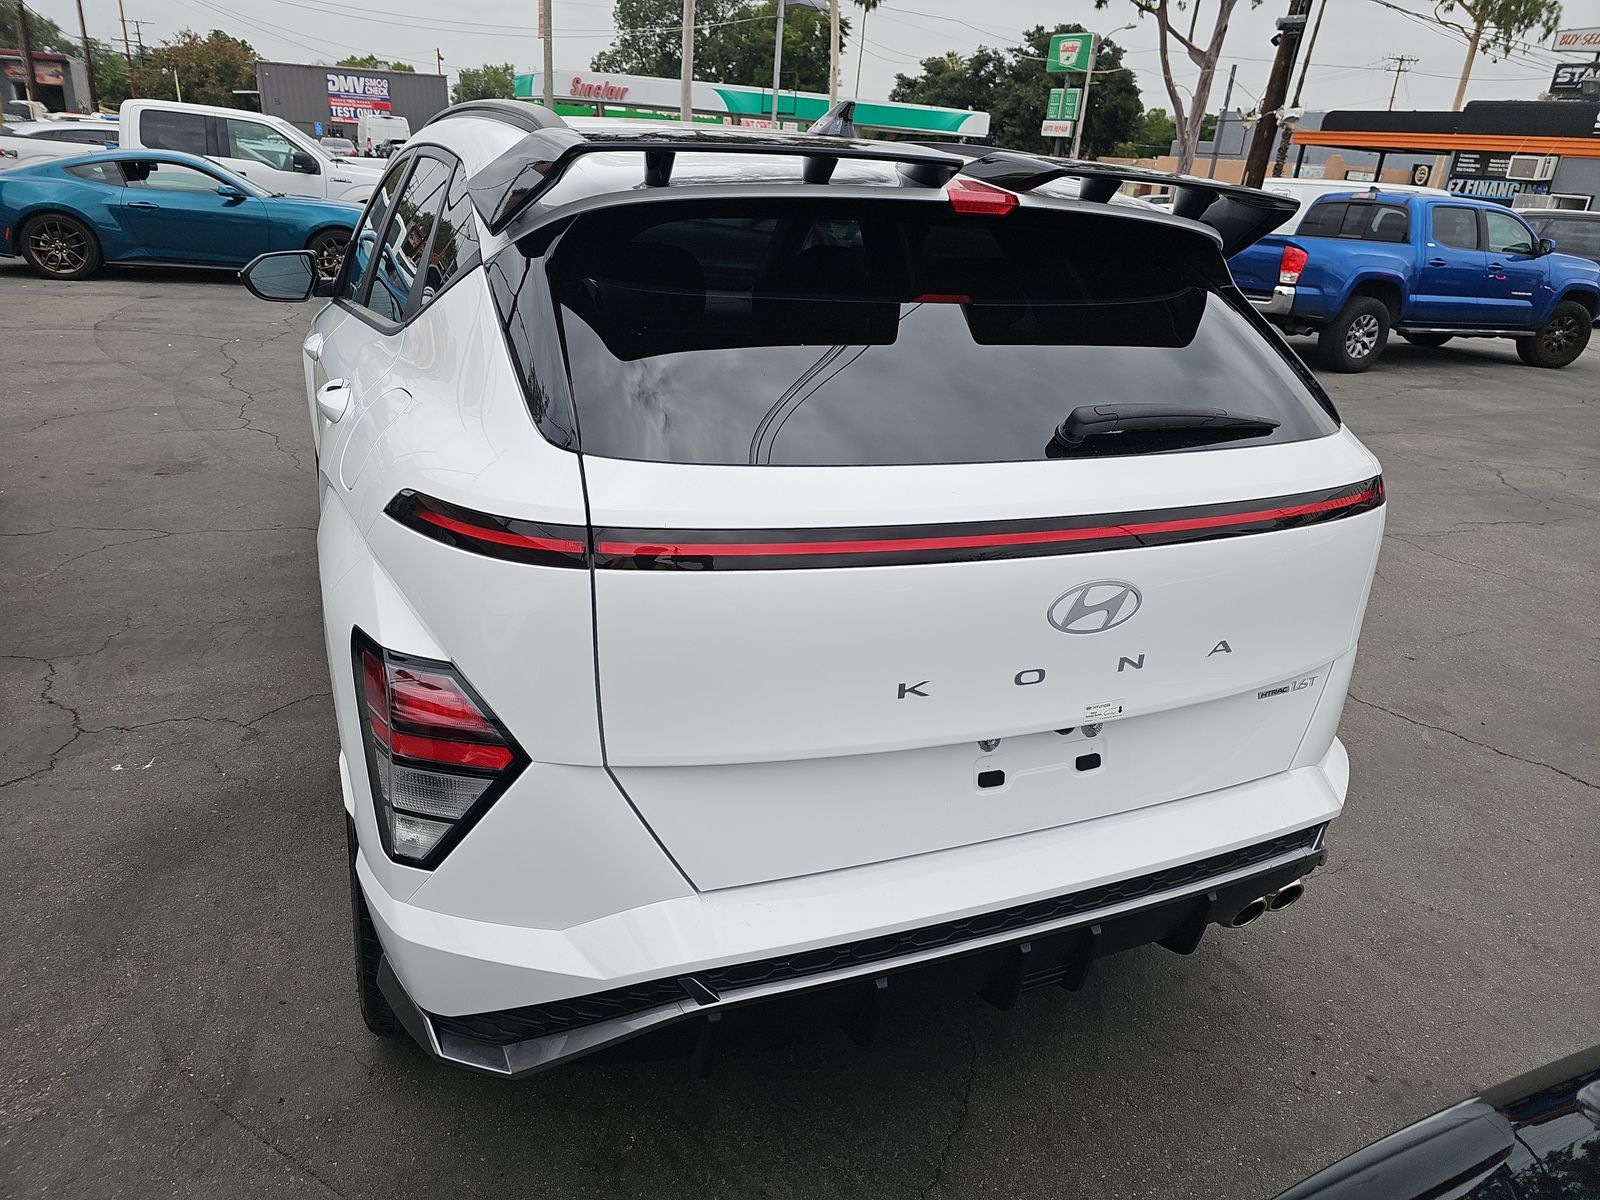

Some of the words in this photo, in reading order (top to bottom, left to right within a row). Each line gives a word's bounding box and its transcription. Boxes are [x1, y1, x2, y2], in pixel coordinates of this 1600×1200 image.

[1560, 34, 1580, 46] BUY
[326, 74, 365, 94] DMV
[365, 77, 388, 87] SMOG
[570, 76, 629, 100] Sinclair
[365, 86, 388, 96] CHECK
[330, 106, 356, 118] TEST
[1447, 179, 1463, 193] EZ
[1258, 685, 1289, 699] HTRAC
